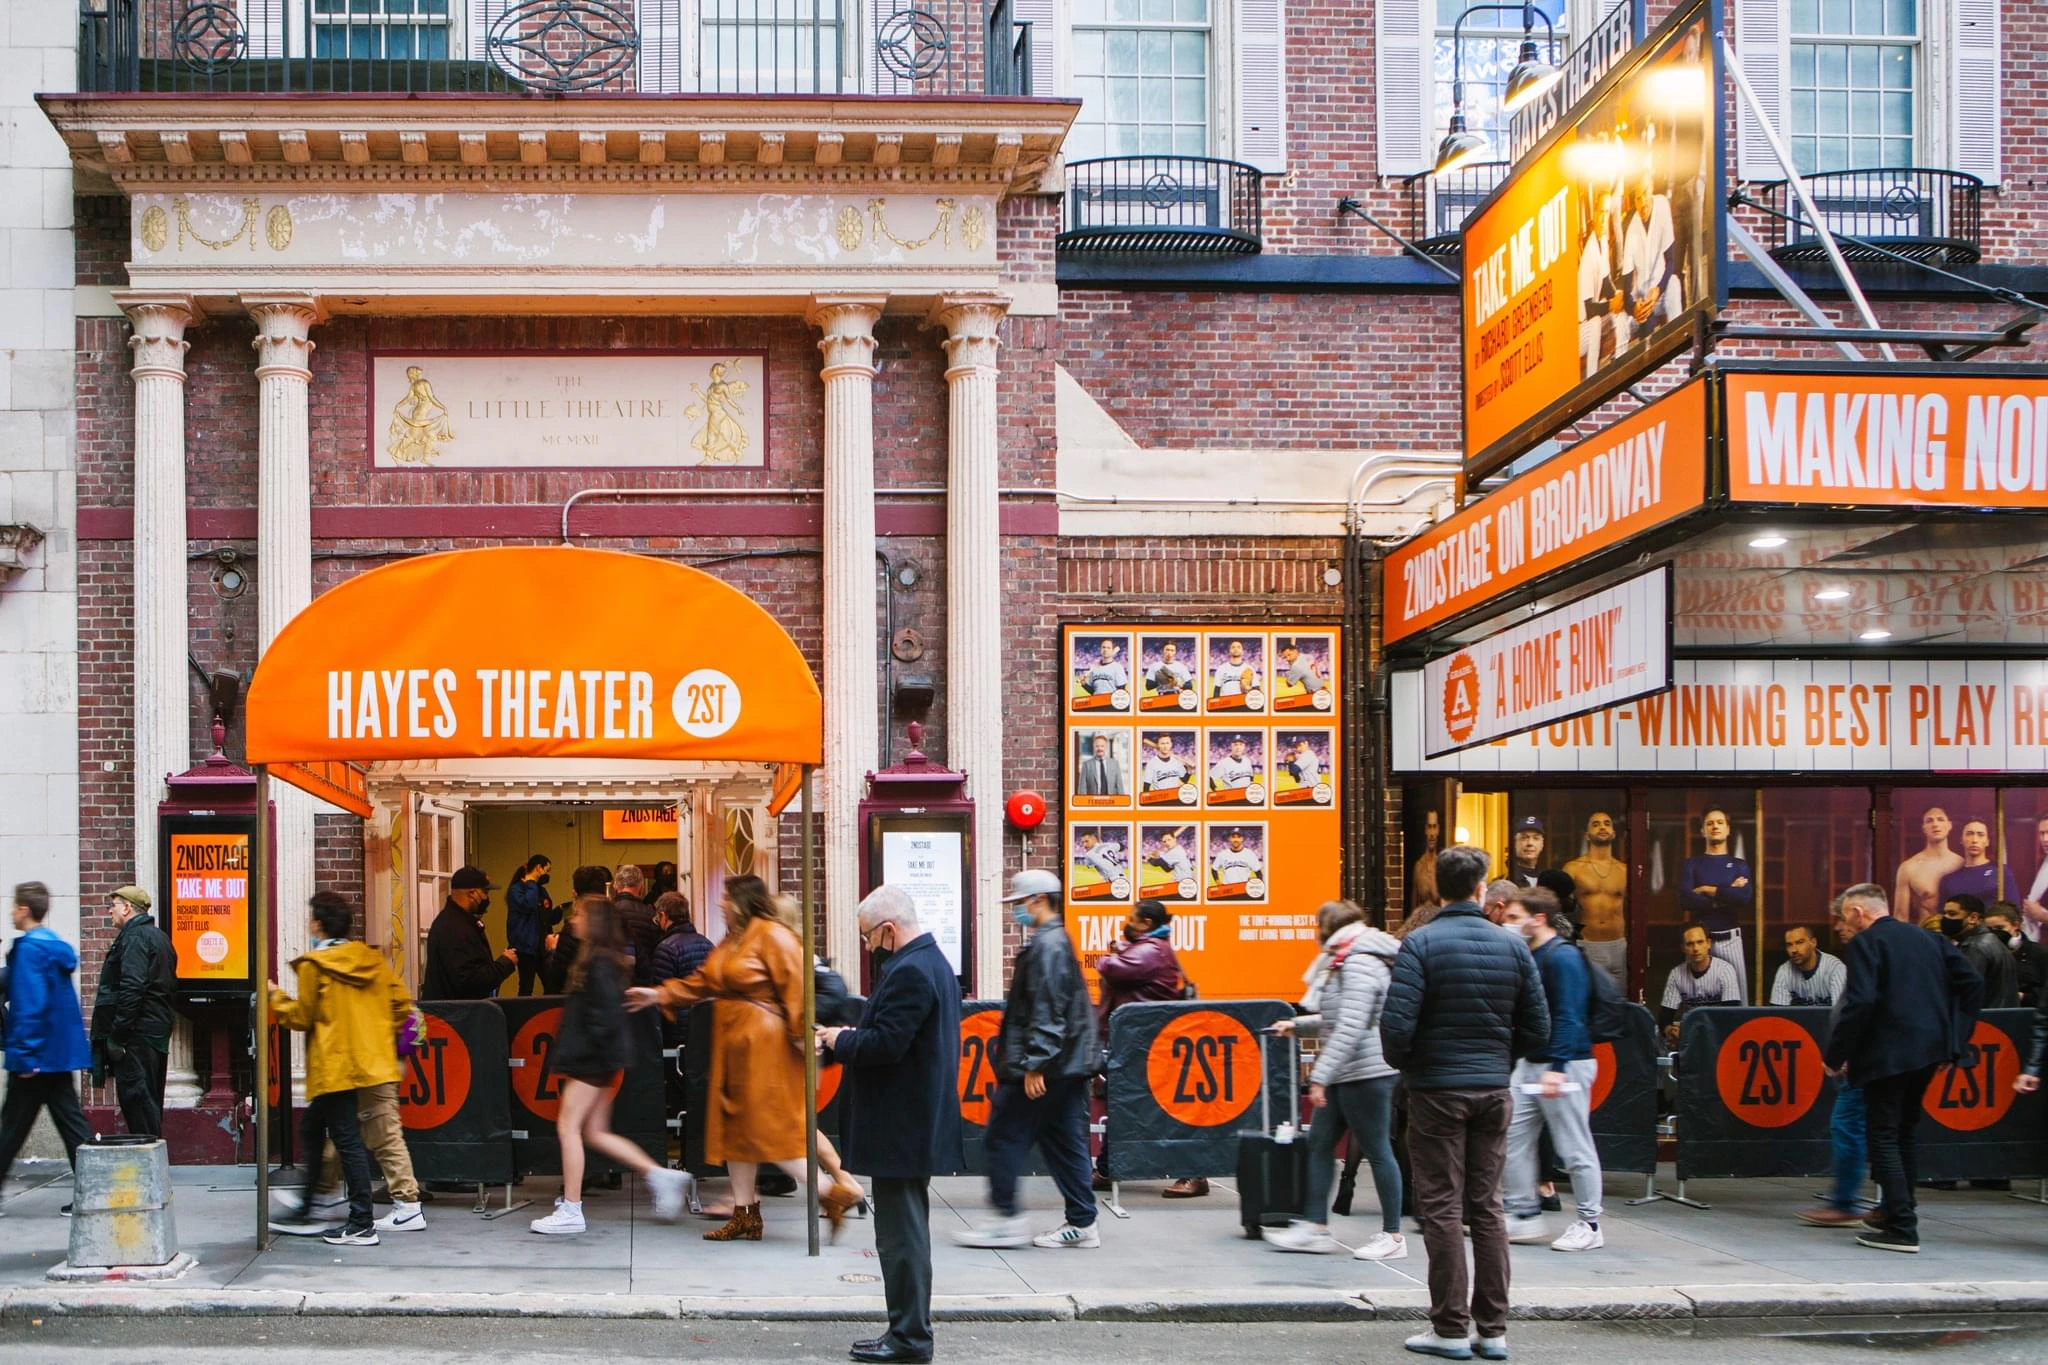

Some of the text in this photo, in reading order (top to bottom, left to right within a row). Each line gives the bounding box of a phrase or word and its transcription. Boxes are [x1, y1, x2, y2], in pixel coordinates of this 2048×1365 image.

[1510, 1, 1632, 168] HAYES THEATER
[1473, 185, 1568, 328] TAKE ME OUT
[1481, 316, 1510, 364] RICHARD
[1500, 348, 1522, 392] SCOTT
[1524, 332, 1543, 373] ELLIS
[469, 400, 672, 420] LITTLE THEATRE
[554, 375, 584, 387] THE
[1745, 391, 1949, 491] MAKING
[1403, 420, 1667, 621] 2NDSTAGE ON BROADWAY
[1512, 629, 1562, 714] HOME
[327, 668, 728, 739] HAYES THEATER 2ST
[1805, 684, 1893, 746] BEST
[1908, 684, 1997, 746] PLAY
[622, 806, 678, 823] 2NDSTAGE
[176, 845, 249, 871] 2NDSTAGE
[176, 878, 247, 899] TAKE ME OUT
[177, 905, 230, 915] RICHARD GREENBERG
[177, 921, 209, 931] SCOTT ELLIS
[1078, 915, 1207, 951] TAKE OUT
[1309, 915, 1320, 926] PL
[399, 1038, 448, 1105] ST
[962, 1035, 1001, 1102] 2S
[1172, 1035, 1239, 1104] 2ST
[1739, 1039, 1802, 1106] 2ST
